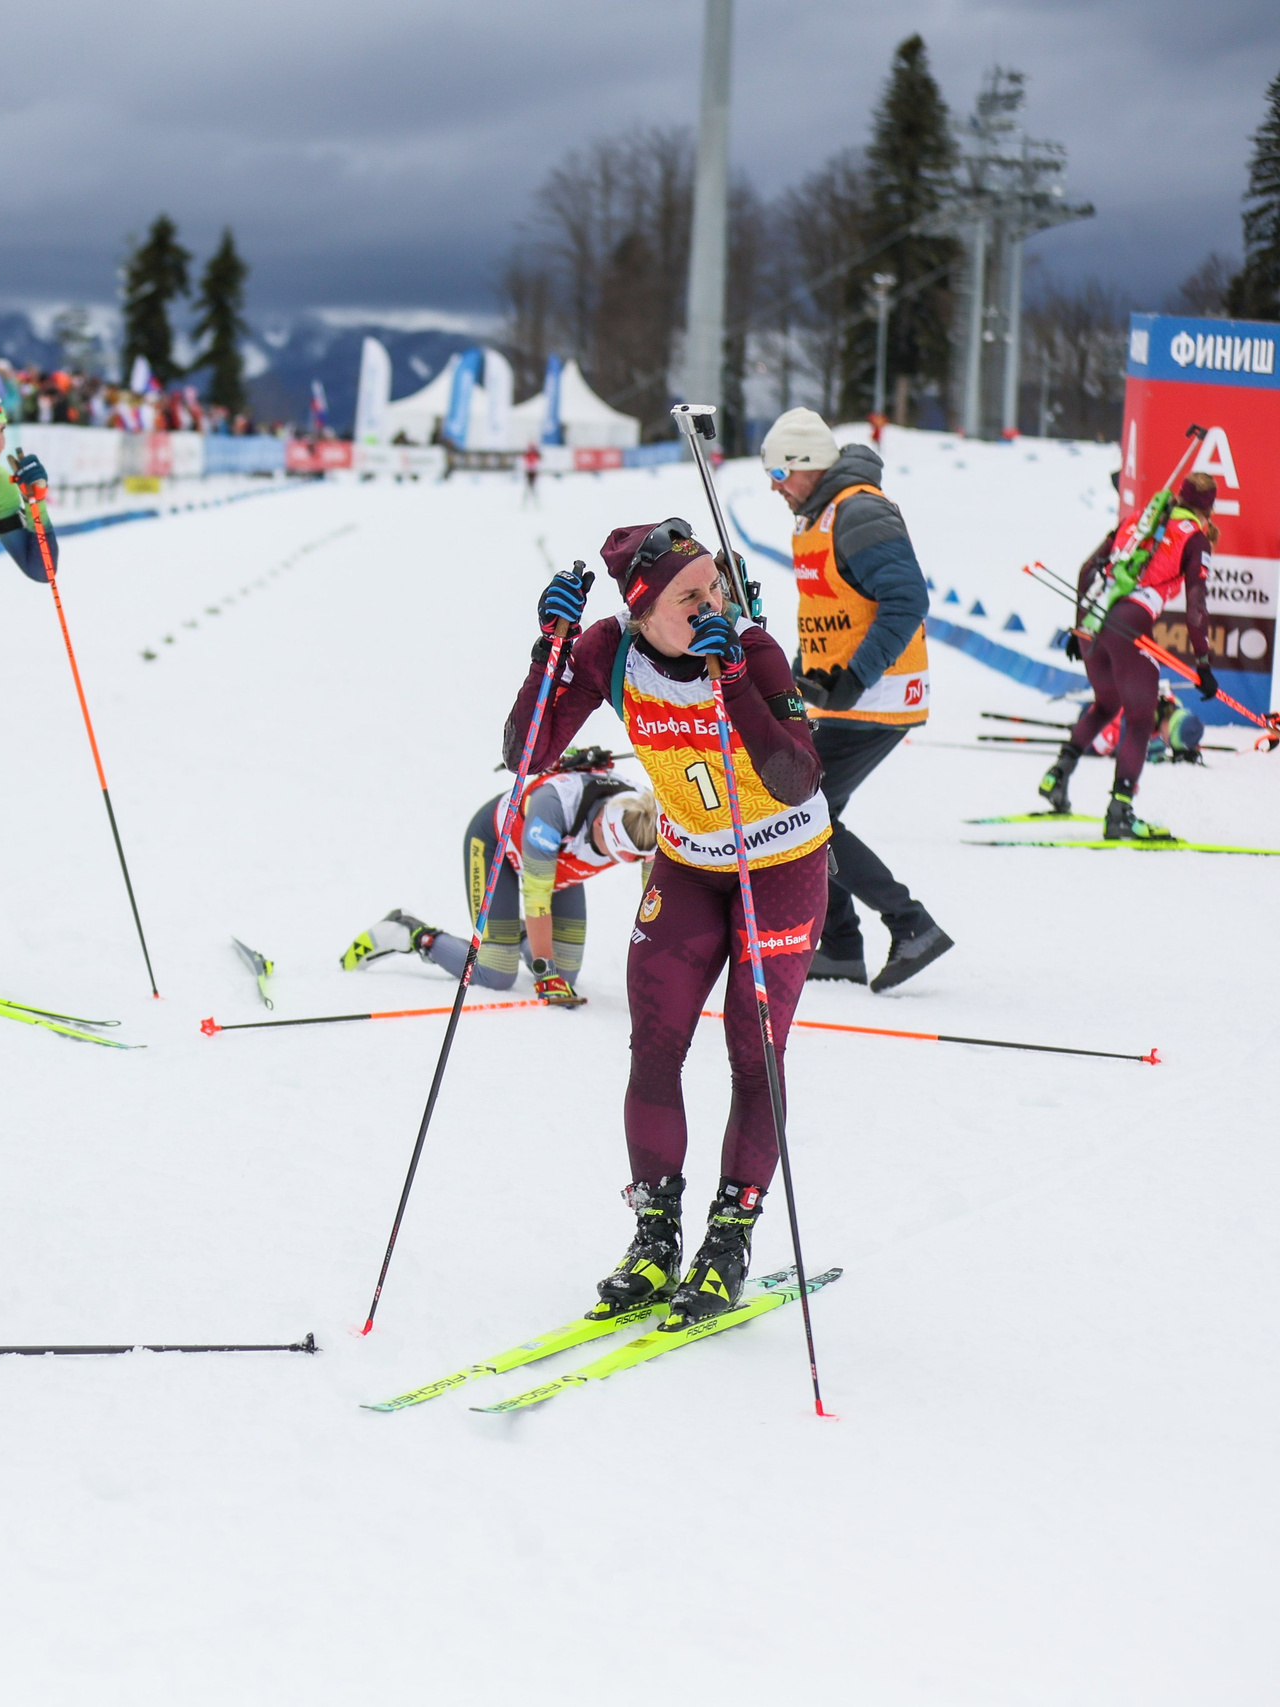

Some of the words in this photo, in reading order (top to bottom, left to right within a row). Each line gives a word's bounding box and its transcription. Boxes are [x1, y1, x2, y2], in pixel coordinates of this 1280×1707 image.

[1170, 330, 1276, 376] ФИНИШ
[636, 714, 691, 737] Альфа
[685, 760, 721, 811] 1
[785, 932, 808, 947] Банк
[614, 1308, 653, 1328] FISCHER
[686, 1319, 718, 1339] FISCHER
[387, 1373, 467, 1408] FISCHER
[493, 1382, 562, 1411] FISCHER
